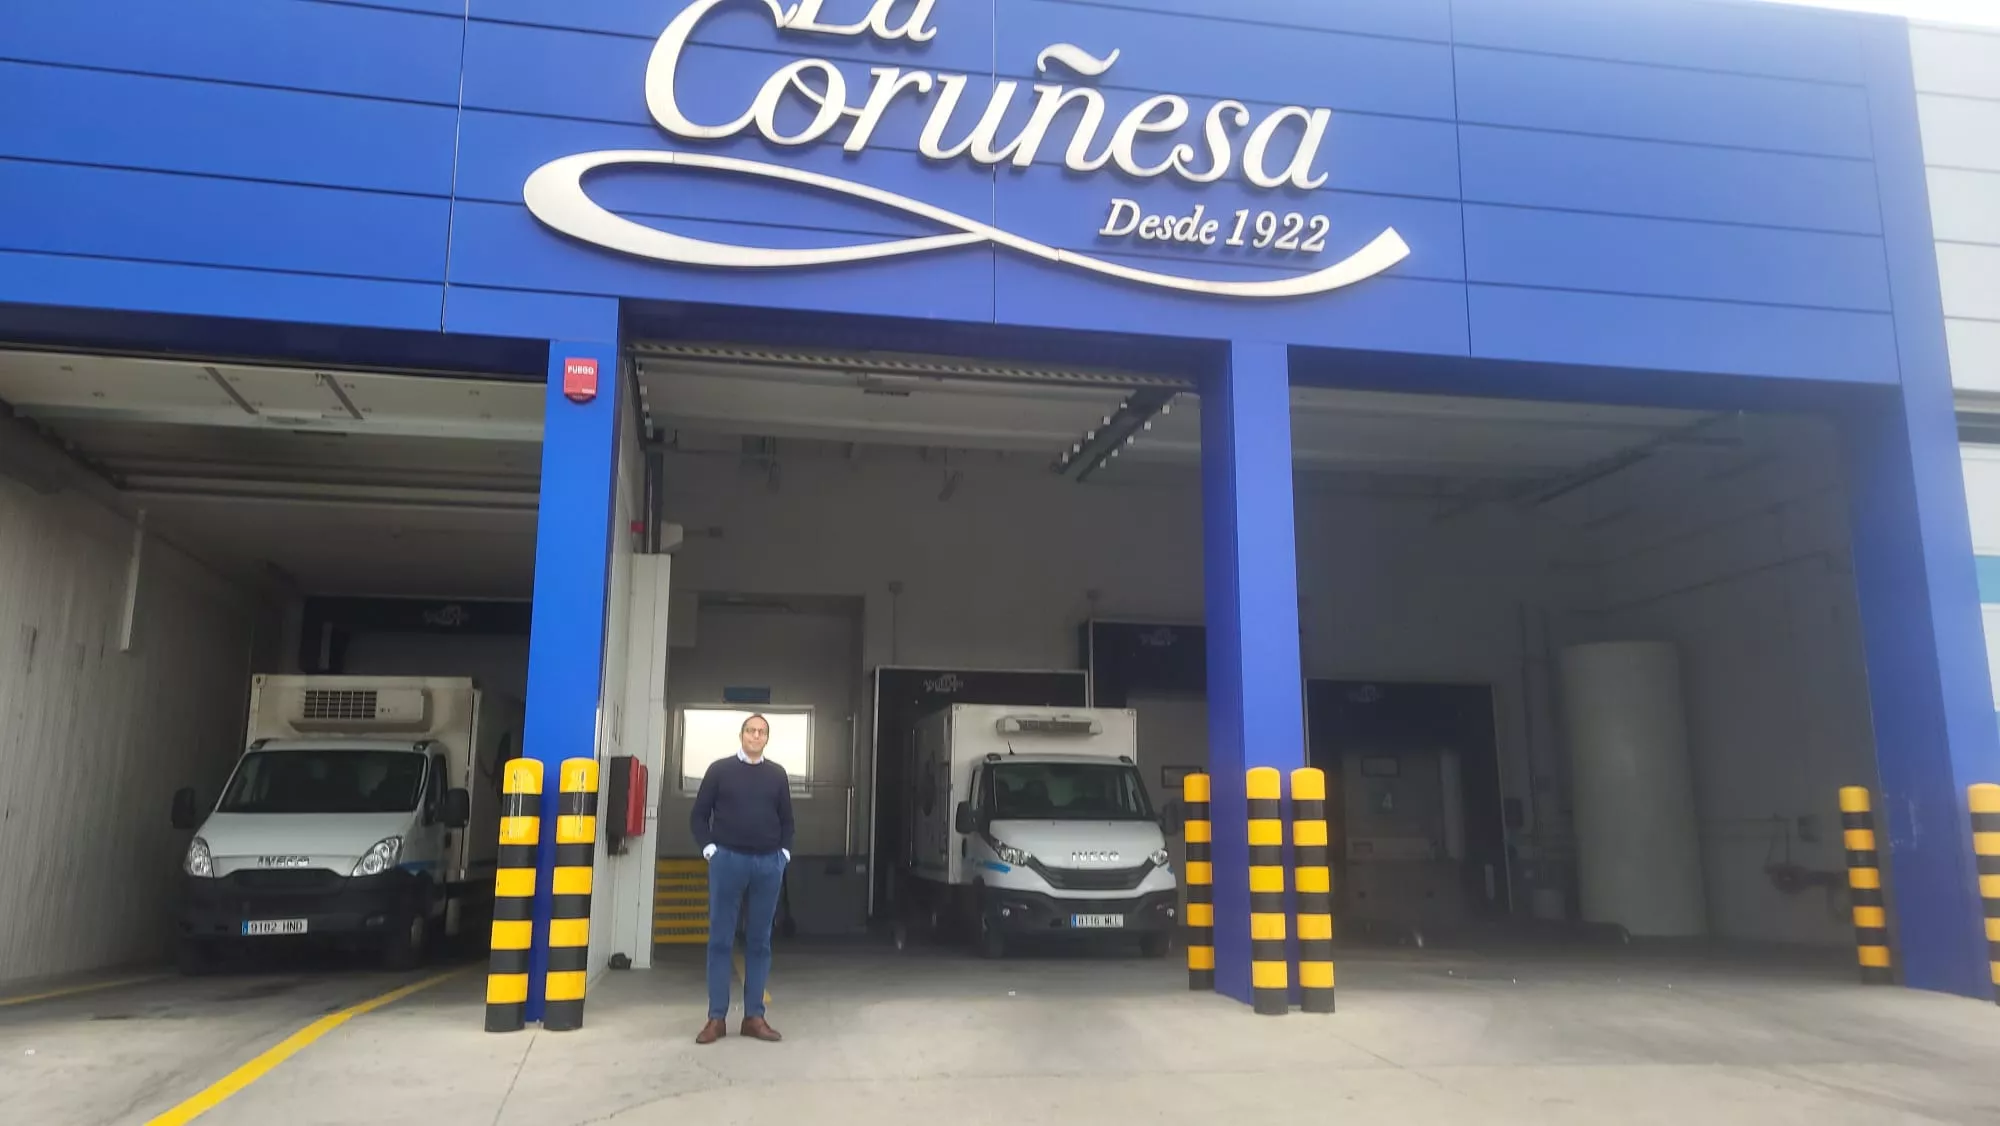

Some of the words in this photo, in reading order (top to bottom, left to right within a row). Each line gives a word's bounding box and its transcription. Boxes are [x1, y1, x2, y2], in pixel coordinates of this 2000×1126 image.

[645, 0, 1332, 189] Coruñesa
[1100, 198, 1218, 246] Desde
[1226, 209, 1330, 252] 1922
[567, 365, 594, 375] FUEGO
[256, 855, 311, 868] IVECO
[1072, 851, 1120, 862] IVECO
